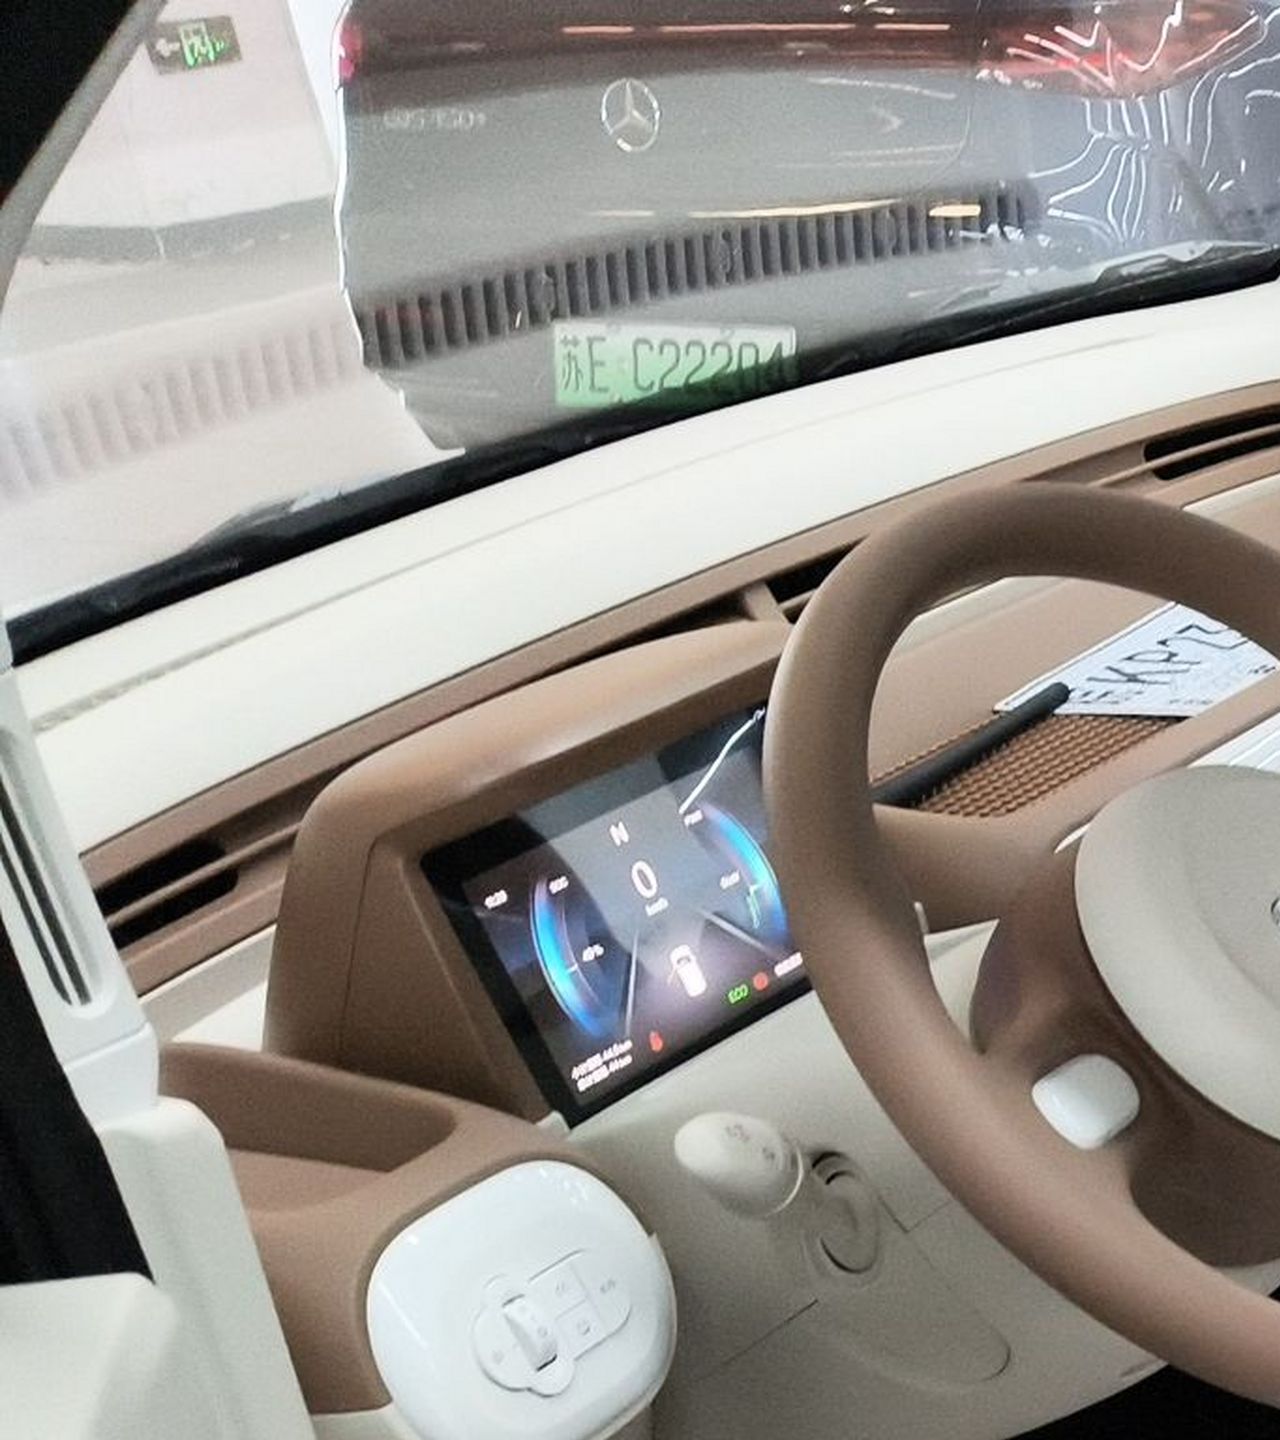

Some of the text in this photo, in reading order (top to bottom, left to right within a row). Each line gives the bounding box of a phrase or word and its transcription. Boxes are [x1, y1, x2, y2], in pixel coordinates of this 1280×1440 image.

[559, 335, 610, 393] 苏E
[609, 821, 630, 847] N
[631, 860, 658, 899] 0
[727, 983, 750, 1004] ECO
